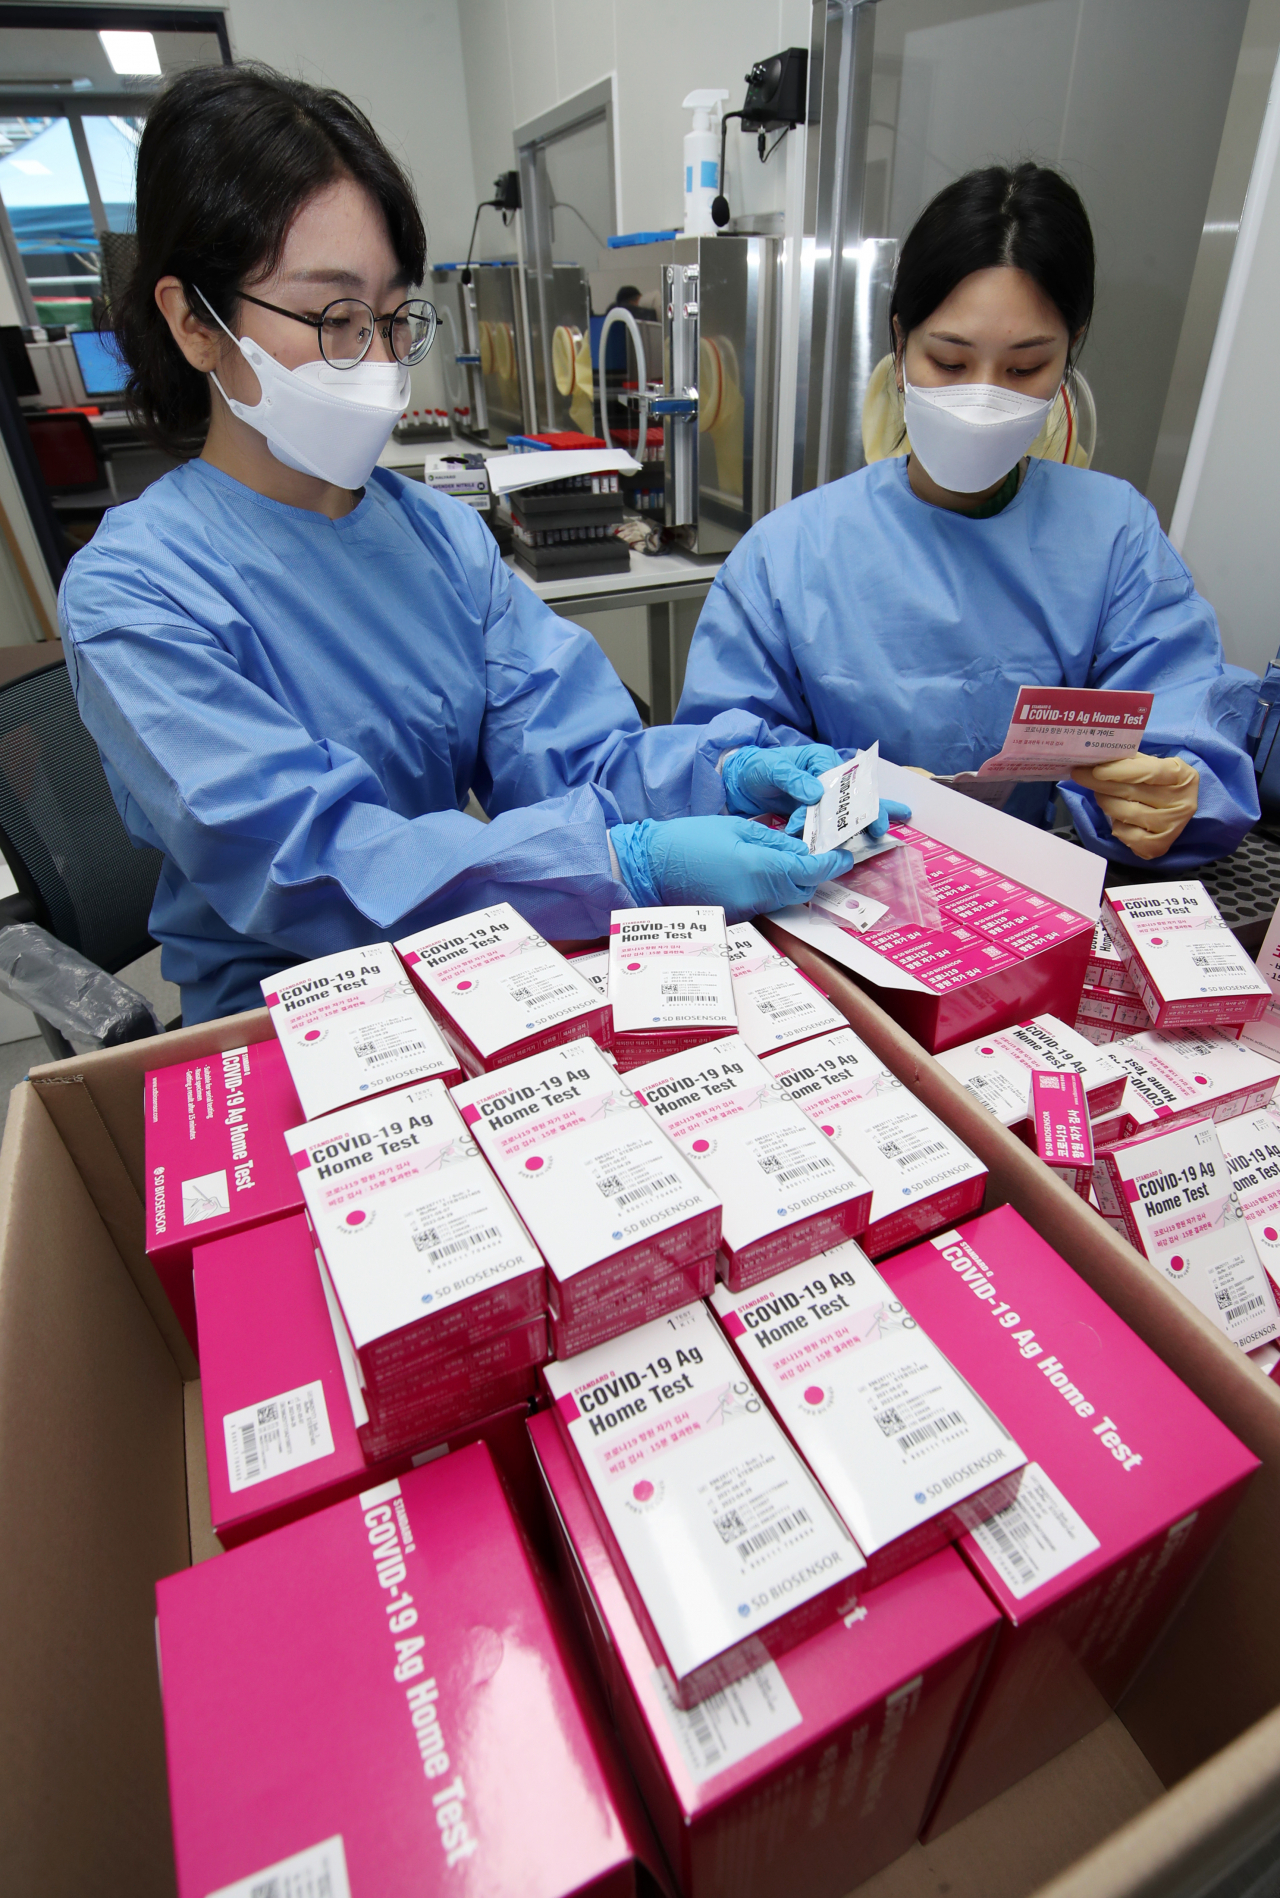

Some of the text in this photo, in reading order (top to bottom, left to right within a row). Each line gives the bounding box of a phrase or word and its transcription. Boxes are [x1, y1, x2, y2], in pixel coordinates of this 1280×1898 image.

[1029, 709, 1144, 724] COVID-19 Ag Home Test
[836, 802, 850, 815] Ag
[838, 811, 849, 831] Test
[1125, 897, 1198, 910] COVID-19 Ag
[1130, 906, 1191, 919] Home Test
[420, 922, 509, 960] COVID-19 Ag
[622, 922, 707, 933] COVID-19 Ag
[622, 933, 659, 942] Home
[427, 935, 502, 968] Home Test
[735, 940, 752, 948] Ag
[935, 949, 950, 958] 검사
[281, 965, 381, 1002] COVID-19 Ag
[928, 969, 959, 984] 코로나19
[965, 968, 982, 977] 검사
[284, 978, 368, 1012] Home Test
[535, 998, 598, 1025] SD BIOSENSOR
[794, 1018, 836, 1033] BIOSENSOR
[1012, 1030, 1067, 1070] Home Test
[1024, 1026, 1087, 1074] COVID-19 Ag
[370, 1061, 444, 1087] SD BIOSENSOR
[646, 1062, 744, 1102] COVID-19 Ag
[780, 1053, 858, 1088] OVID-19 Ag
[792, 1068, 853, 1100] ome Test
[1124, 1057, 1177, 1104] Home Test
[194, 1080, 203, 1101] specimen
[480, 1068, 590, 1117] COVID-19 Ag
[654, 1077, 737, 1116] Home Test
[222, 1055, 256, 1192] COVID-19 Ag Home Test
[488, 1086, 581, 1131] Home Test
[1067, 1110, 1081, 1124] 검사
[189, 1120, 197, 1140] minutes
[311, 1114, 434, 1164] COVID-19 Ag
[1043, 1111, 1052, 1142] BIOSENSOR
[1056, 1125, 1069, 1157] 코로나19
[1069, 1126, 1082, 1141] 자가
[1194, 1135, 1200, 1145] 1
[317, 1133, 420, 1180] Home Test
[1071, 1143, 1085, 1158] 항원
[911, 1162, 972, 1192] SD BIOSENSOR
[1136, 1170, 1158, 1182] STANDARD
[1139, 1161, 1215, 1199] COVID-19 Ag
[1233, 1162, 1280, 1192] ome Test
[155, 1174, 166, 1235] SD BIOSENSOR
[787, 1180, 857, 1213] SD BIOSENSOR
[1145, 1182, 1210, 1217] Home Test
[623, 1196, 702, 1235] SD BIOSENSOR
[1154, 1212, 1207, 1237] 코로나19 자가 검사
[1157, 1221, 1212, 1247] 비강 검사 15분 결과판독
[960, 1241, 989, 1272] STANDARD
[434, 1255, 525, 1298] SD BIOSENSOR
[738, 1296, 769, 1313] STANDARD
[743, 1270, 855, 1330] COVID-19 Ag
[667, 1319, 676, 1330] 1
[754, 1293, 849, 1349] Home Test
[1239, 1324, 1277, 1347] BIOSENSOR
[942, 1246, 1143, 1472] COVID-19 Ag Home Test
[574, 1374, 610, 1395] STANDARD
[579, 1345, 703, 1414] COVID-19 Ag
[589, 1372, 694, 1436] Home Test
[926, 1449, 1007, 1499] SD BIOSENSOR
[393, 1498, 413, 1544] STANDARD
[752, 1551, 843, 1612] SD BIOSENSOR
[364, 1504, 480, 1869] COVID-19 Ag Home Test
